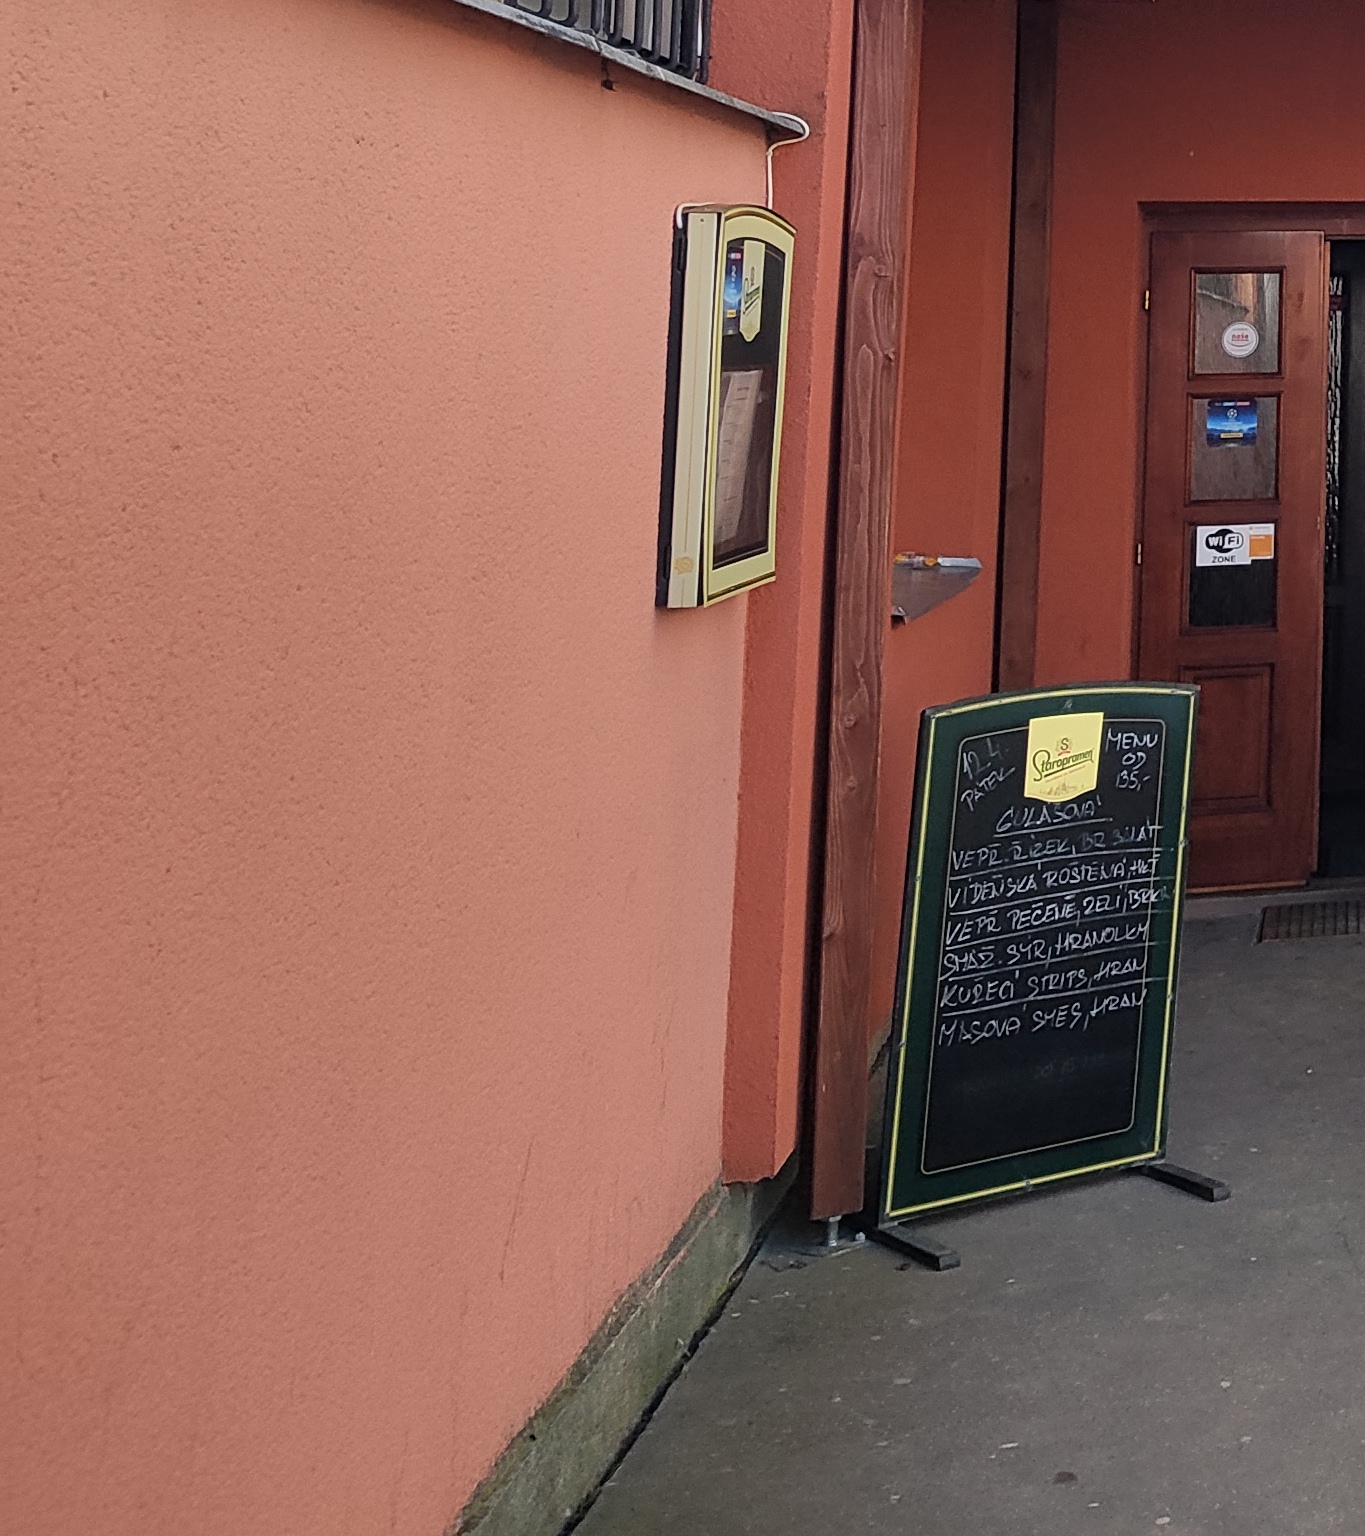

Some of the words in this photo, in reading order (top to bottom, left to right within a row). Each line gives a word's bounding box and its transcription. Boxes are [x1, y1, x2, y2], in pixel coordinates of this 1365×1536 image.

[1211, 555, 1236, 563] ZONE
[1105, 728, 1158, 752] MENU
[1032, 749, 1095, 782] Staropramen
[1122, 751, 1147, 772] OD
